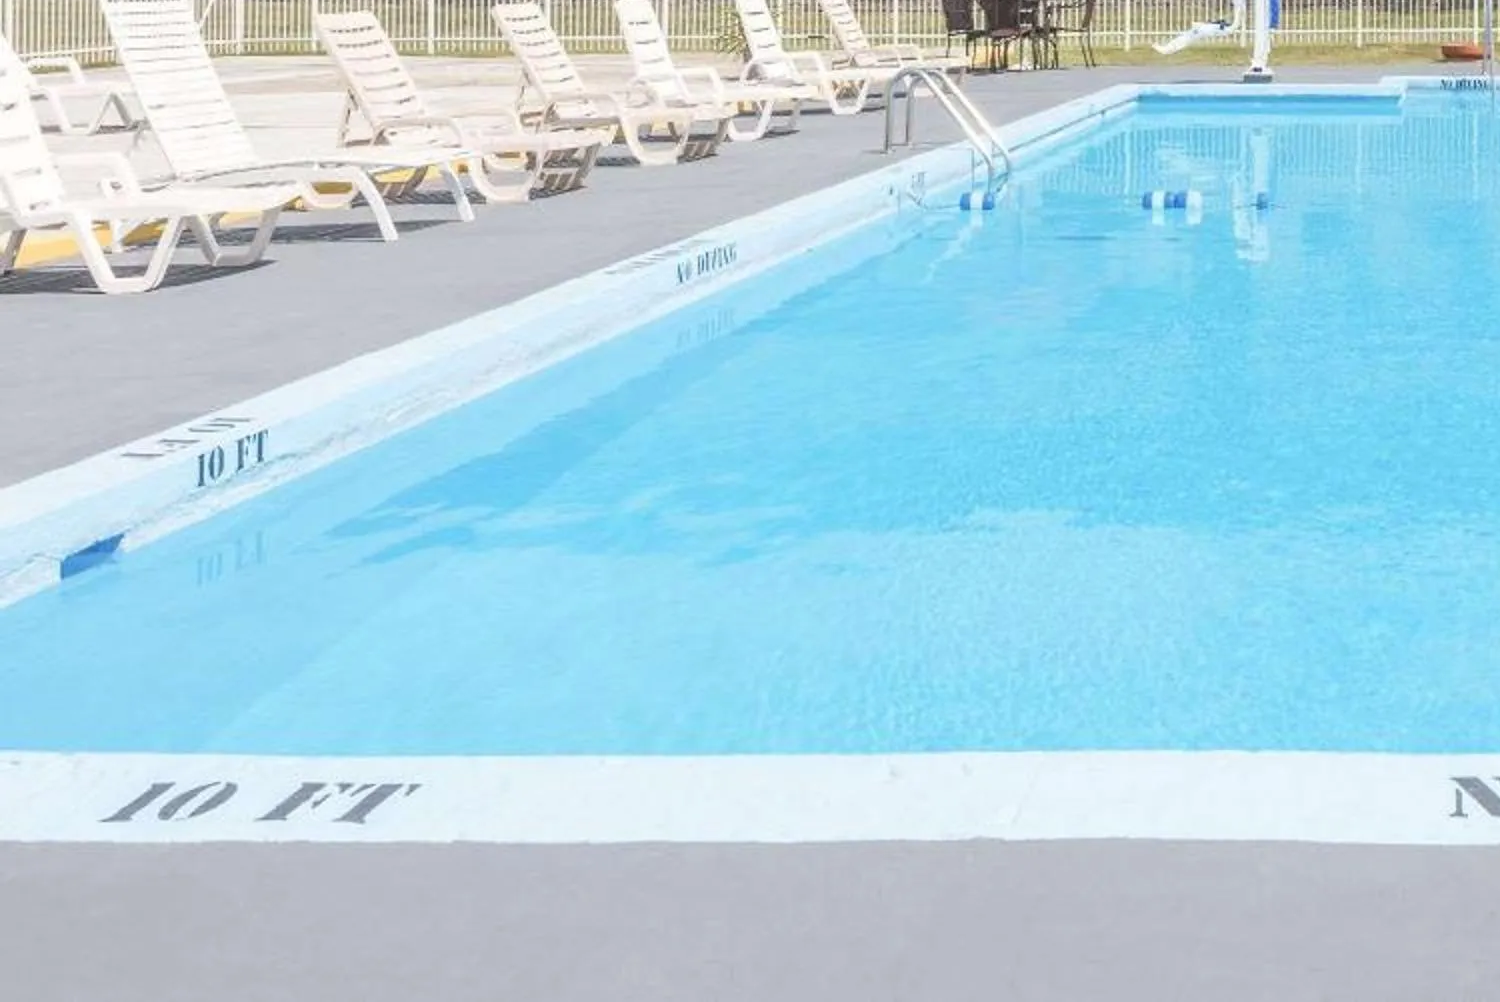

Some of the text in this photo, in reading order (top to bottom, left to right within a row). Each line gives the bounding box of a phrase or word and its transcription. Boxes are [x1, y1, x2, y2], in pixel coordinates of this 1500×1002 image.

[697, 243, 738, 276] DIVING
[197, 429, 269, 487] 10 FT
[97, 781, 423, 825] 10 FT
